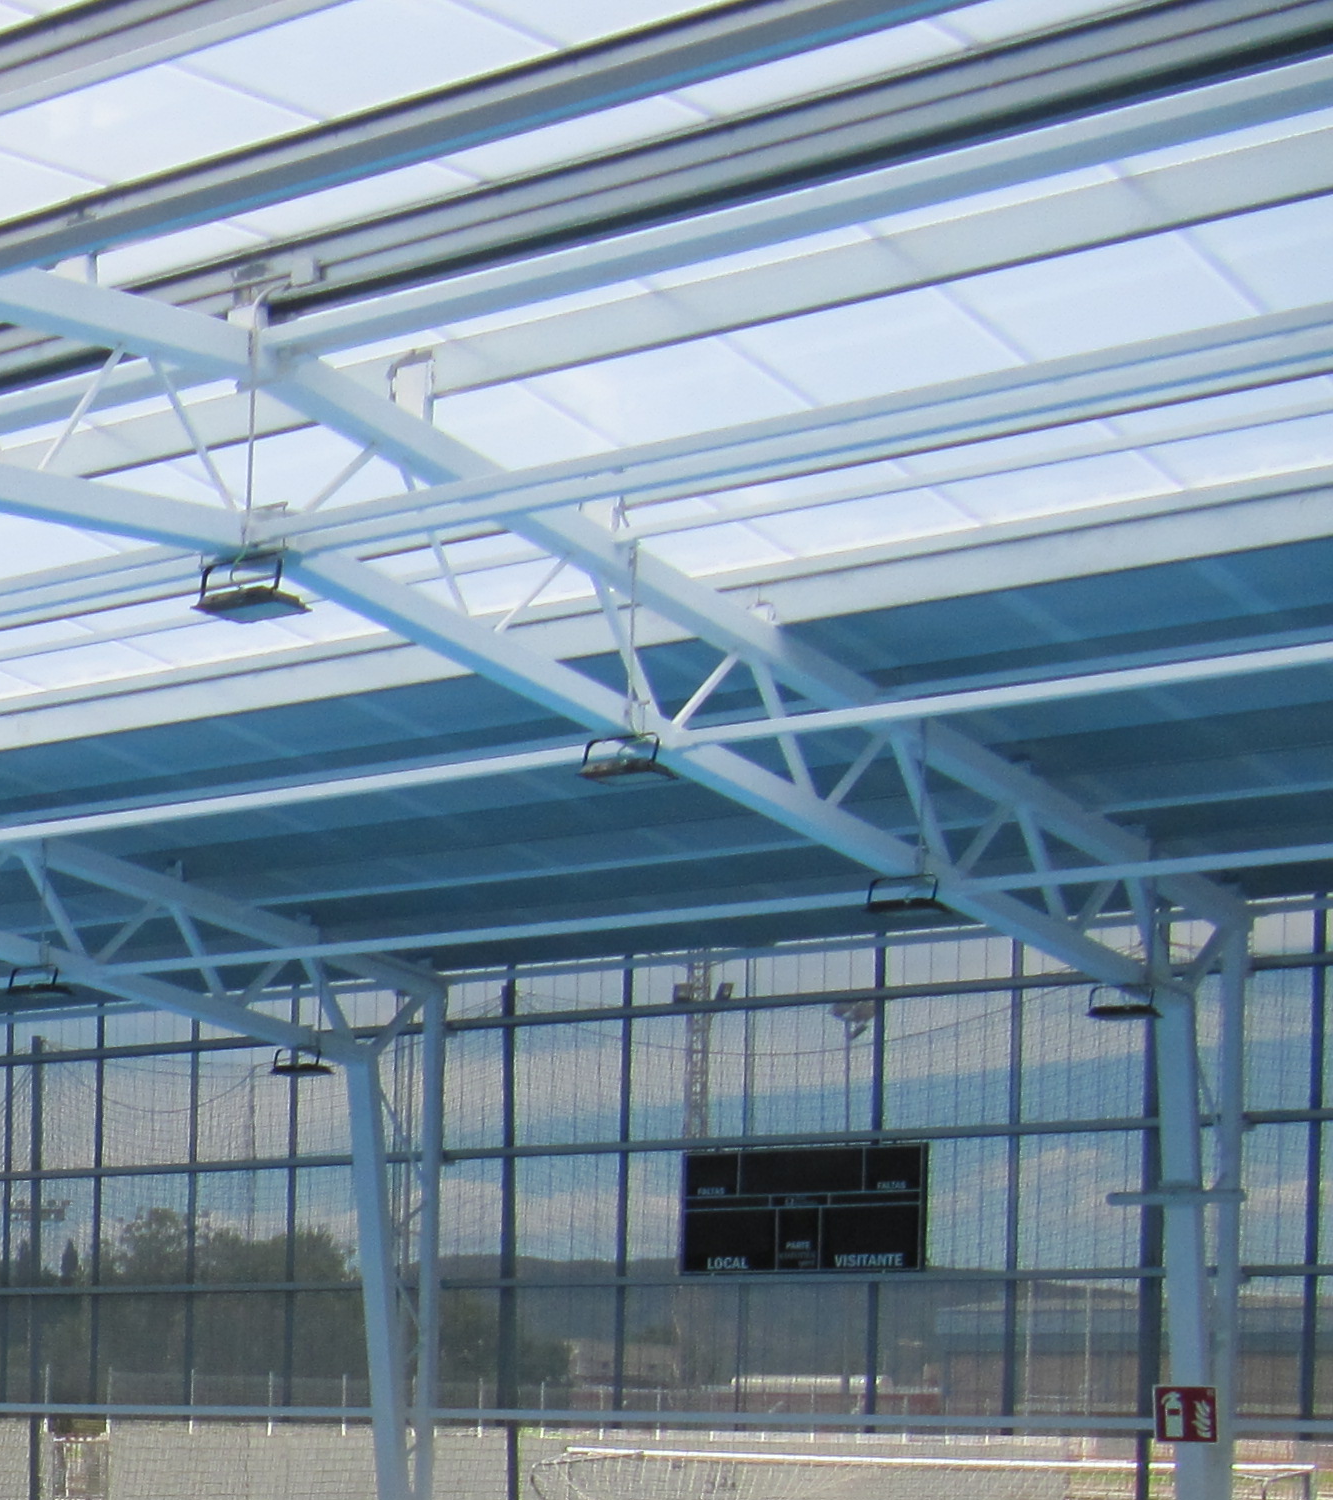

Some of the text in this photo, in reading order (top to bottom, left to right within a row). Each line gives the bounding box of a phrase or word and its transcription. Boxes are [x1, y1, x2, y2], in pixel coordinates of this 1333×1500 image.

[877, 1181, 906, 1189] FALTAS
[707, 1256, 748, 1269] LOCAL
[834, 1253, 903, 1269] VISITANTE
